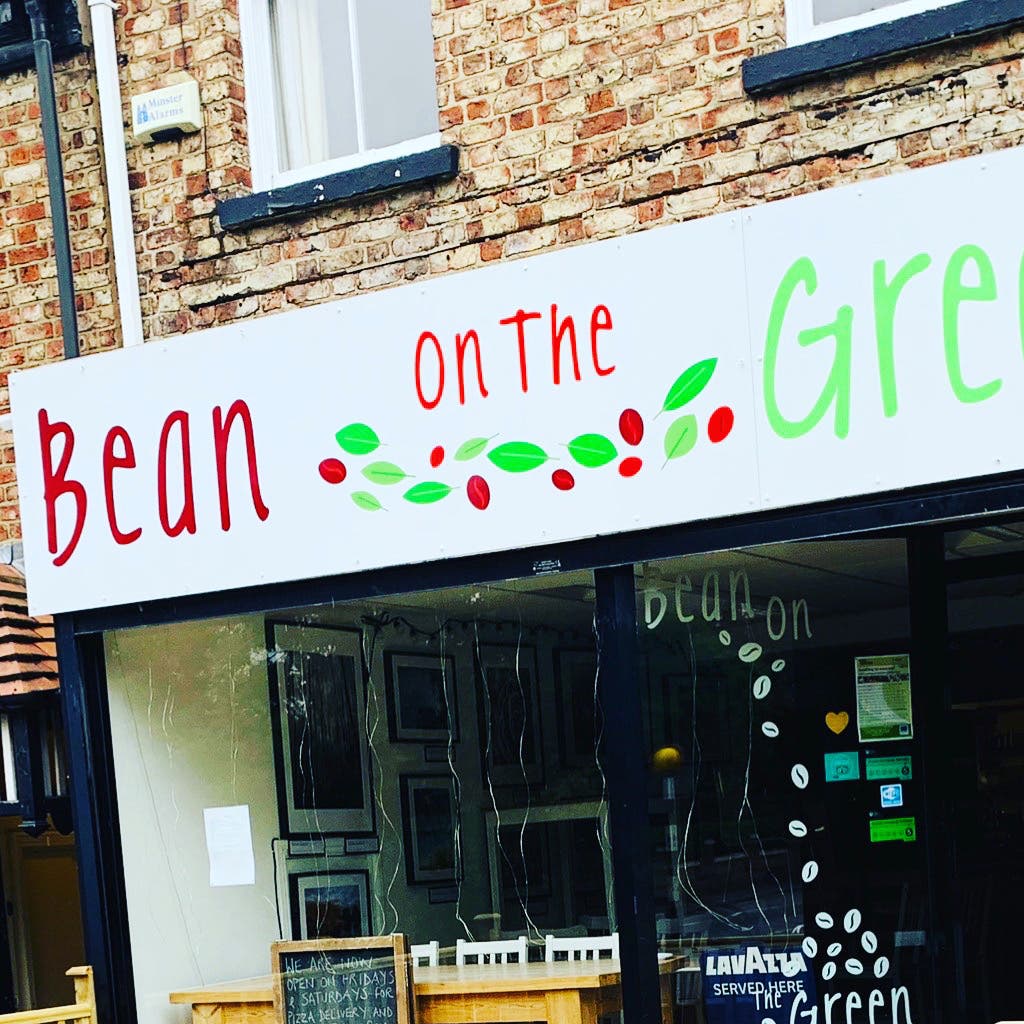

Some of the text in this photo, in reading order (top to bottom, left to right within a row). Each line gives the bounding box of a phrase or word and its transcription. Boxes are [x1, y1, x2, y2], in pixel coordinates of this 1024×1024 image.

[149, 94, 183, 107] Minster
[150, 108, 184, 120] Alarms
[37, 399, 270, 567] Bean
[286, 970, 395, 992] OPEN ON FRIDAYS
[713, 980, 804, 996] SERVED HERE
[319, 1006, 367, 1022] DELIVERY
[373, 1006, 394, 1018] AND
